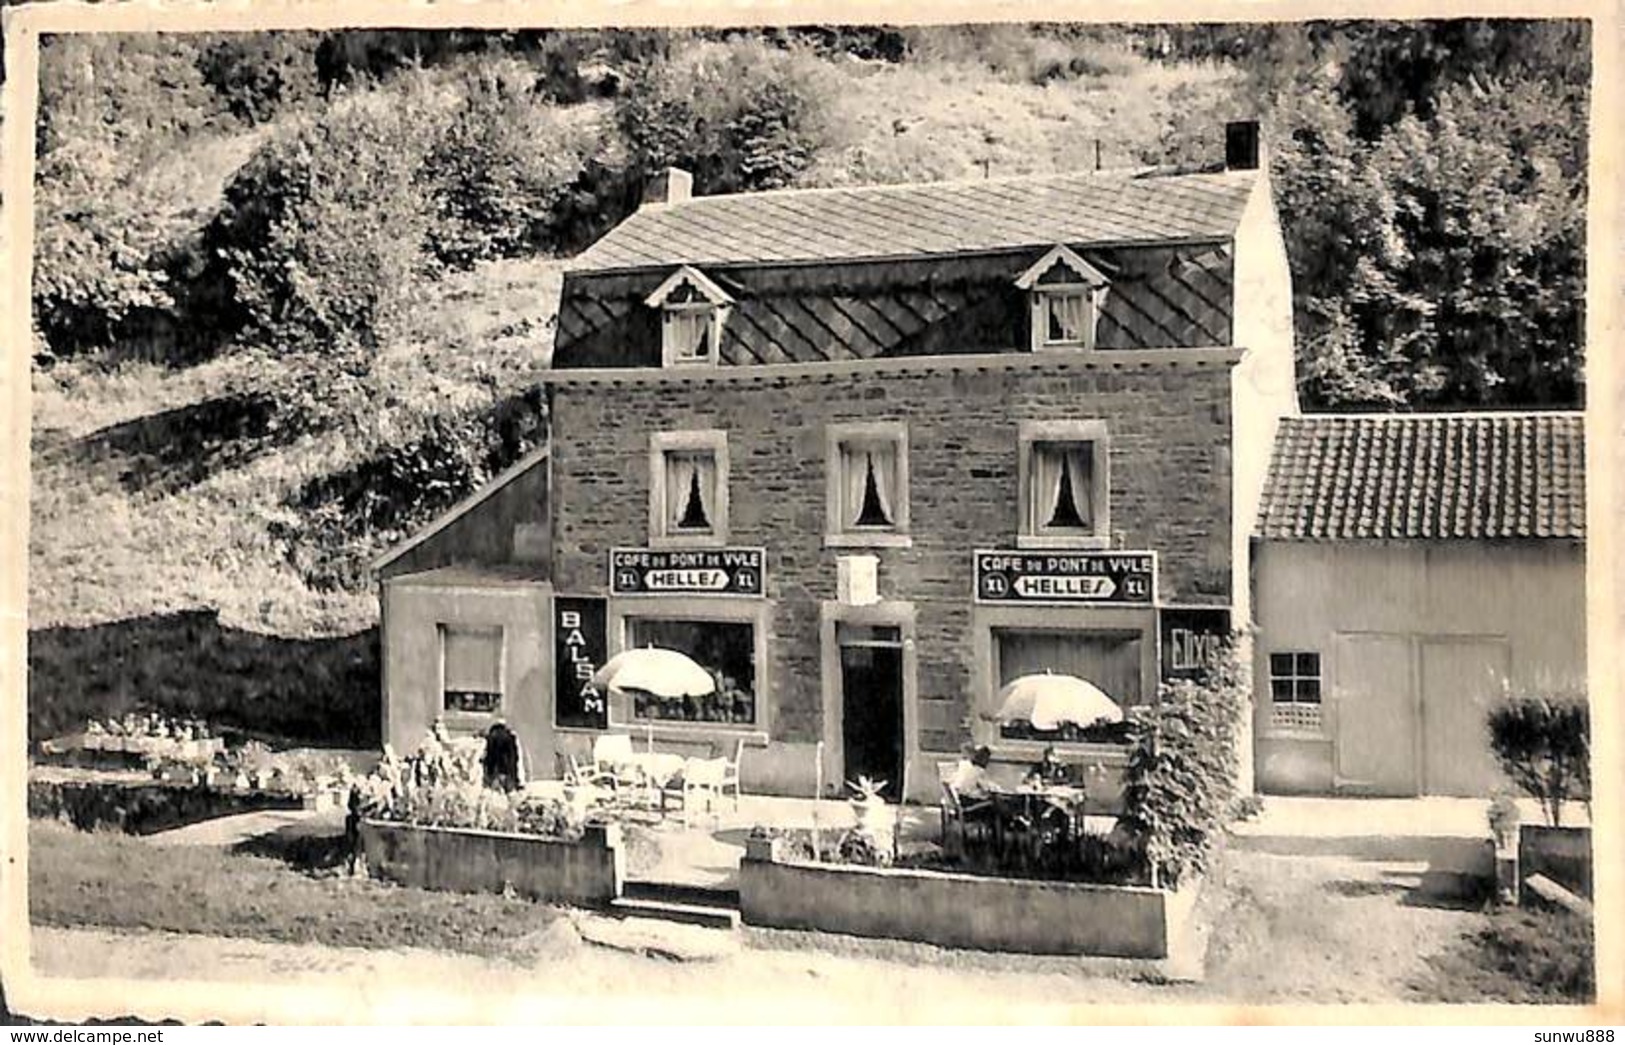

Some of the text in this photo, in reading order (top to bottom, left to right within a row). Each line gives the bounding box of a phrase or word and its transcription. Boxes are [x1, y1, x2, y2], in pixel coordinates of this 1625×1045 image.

[614, 553, 649, 567] CAFE
[670, 553, 706, 567] PONT
[981, 557, 1023, 571] CAFE
[1047, 557, 1090, 571] PONT
[652, 572, 721, 586] HELLES
[986, 578, 1145, 594] XL HELLES XL
[561, 611, 604, 713] BALSAM
